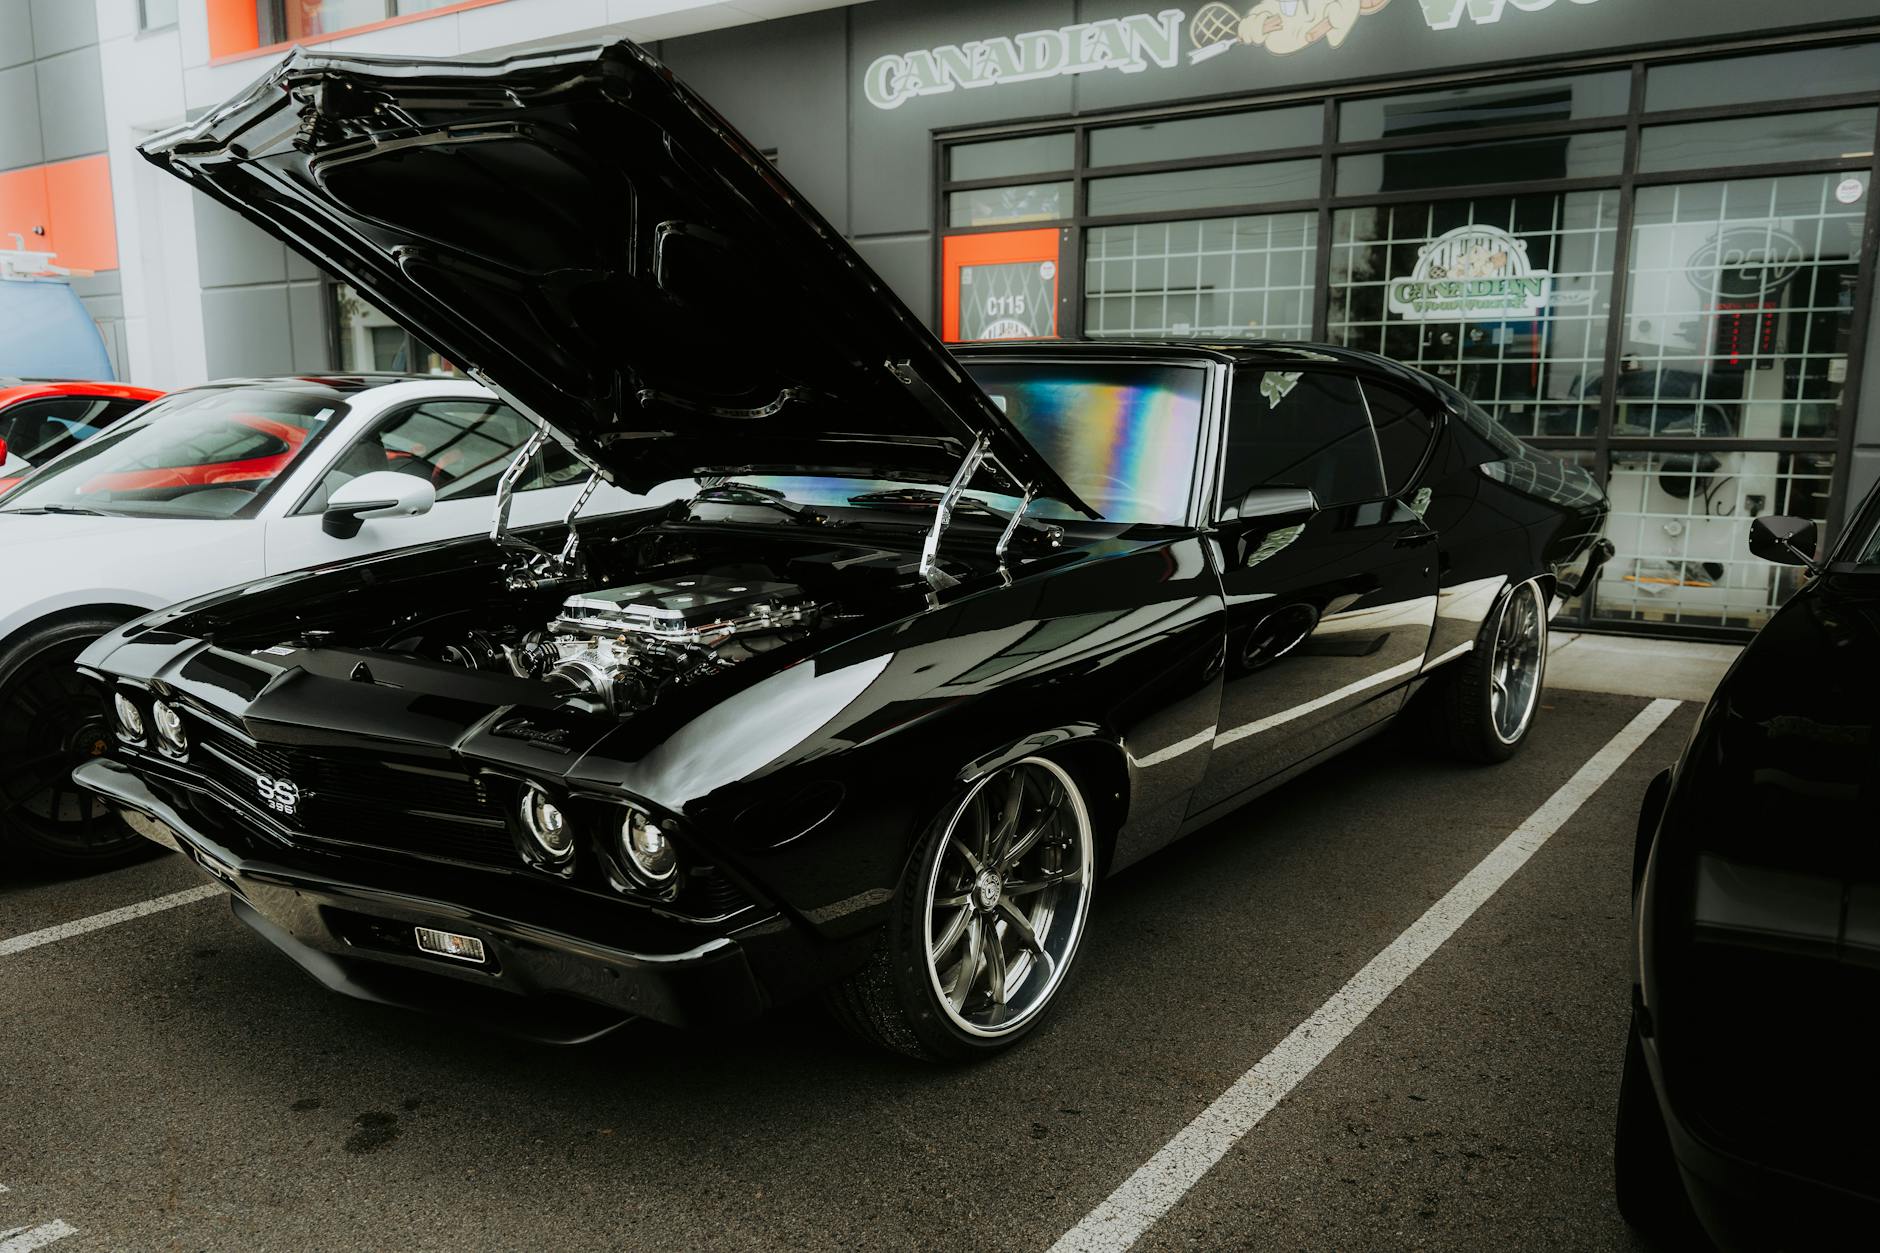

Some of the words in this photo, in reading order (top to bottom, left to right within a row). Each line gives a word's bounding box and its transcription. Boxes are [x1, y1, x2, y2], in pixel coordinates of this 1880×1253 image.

[865, 9, 1185, 109] CANADIAN
[1692, 247, 1793, 281] OPEN
[1395, 278, 1544, 304] CANADIAN
[987, 295, 1025, 316] C115
[256, 775, 296, 805] SS
[268, 799, 294, 814] 396
